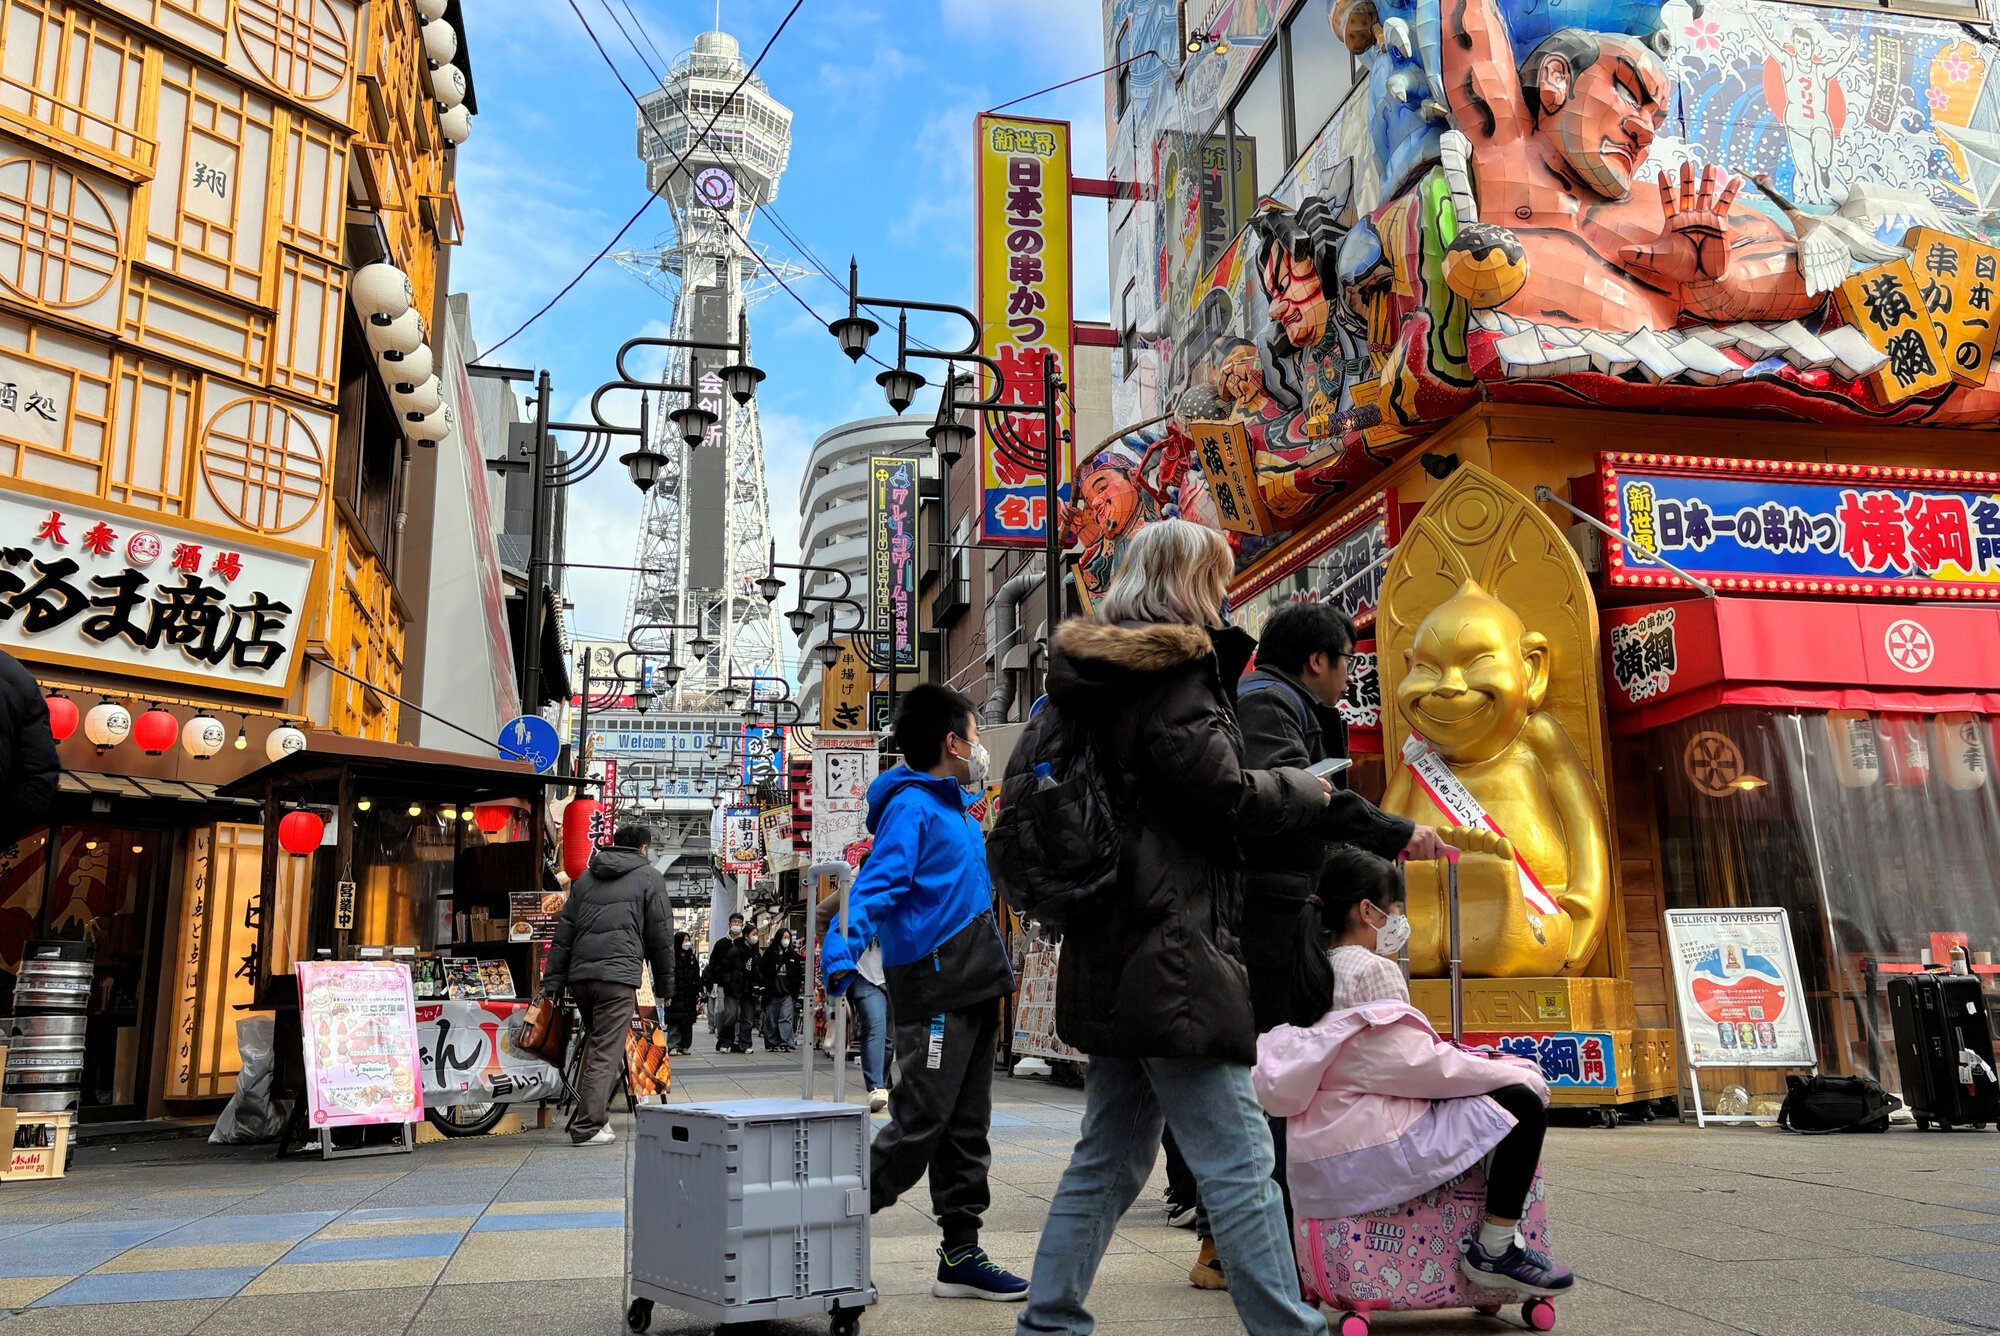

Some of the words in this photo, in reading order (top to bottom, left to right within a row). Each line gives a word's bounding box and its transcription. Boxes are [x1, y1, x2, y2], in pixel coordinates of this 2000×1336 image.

[992, 128, 1055, 156] 新世界
[1006, 157, 1045, 343] 日本一の串かつ
[1659, 503, 1836, 548] 日本一の串かつ
[1842, 495, 1972, 572] 横綱
[1614, 626, 1675, 687] 横綱
[841, 654, 855, 695] 串揚げ
[619, 734, 665, 749] Welcome
[672, 735, 685, 749] to
[665, 781, 689, 795] 南海
[738, 818, 753, 850] 串カツ
[338, 884, 353, 927] 営業中
[1672, 916, 1717, 924] BILLIKEN
[1721, 914, 1778, 923] DIVERSITY
[1580, 1039, 1603, 1081] 名門
[11, 1153, 40, 1165] Asahi
[1365, 1221, 1405, 1239] HELLO
[1365, 1236, 1402, 1254] KITTY
